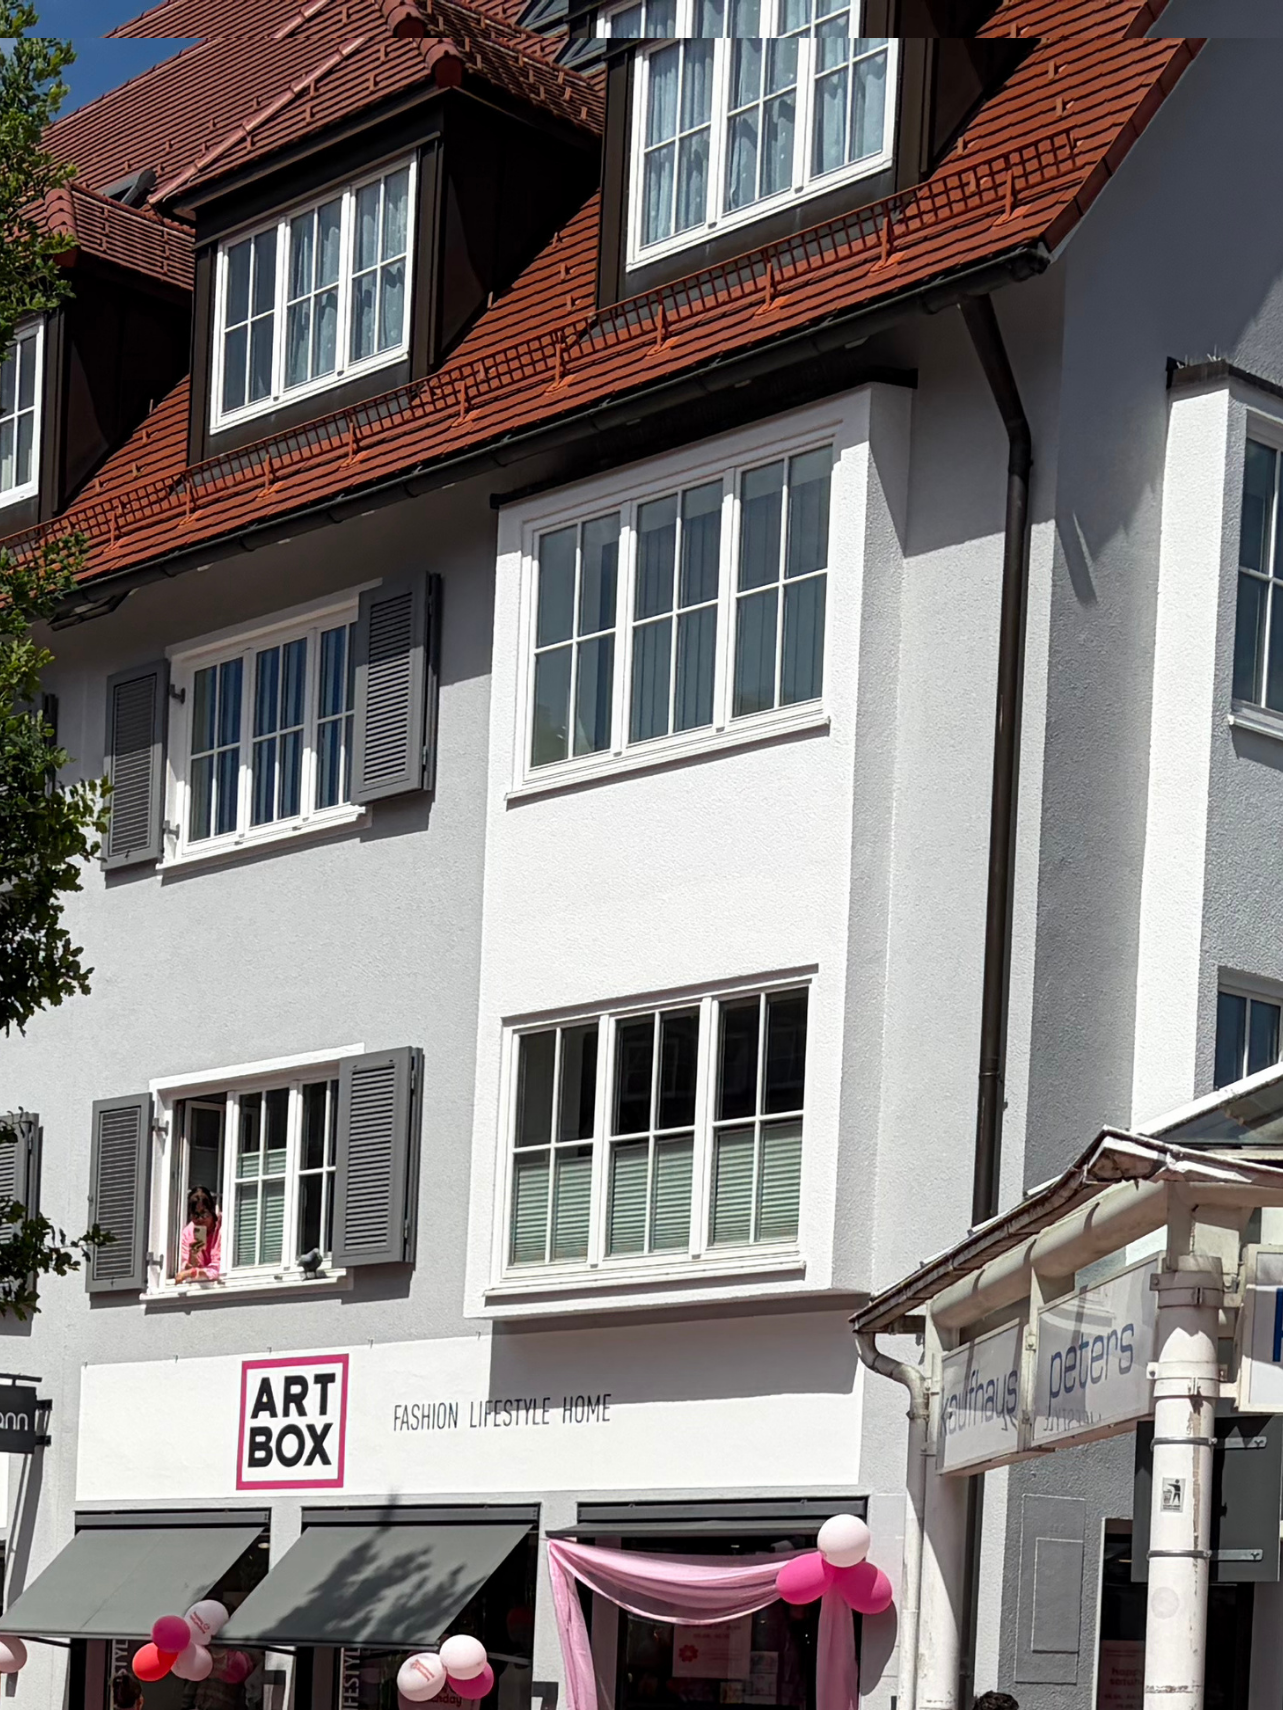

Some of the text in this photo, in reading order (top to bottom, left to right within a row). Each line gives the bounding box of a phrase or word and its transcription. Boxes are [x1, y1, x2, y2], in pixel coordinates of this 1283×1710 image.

[1049, 1323, 1134, 1416] peters
[251, 1373, 336, 1419] ART
[393, 1394, 611, 1431] FASHION LIFESTYLE HOME
[940, 1369, 1018, 1437] kaufhaus
[247, 1422, 333, 1468] BOX
